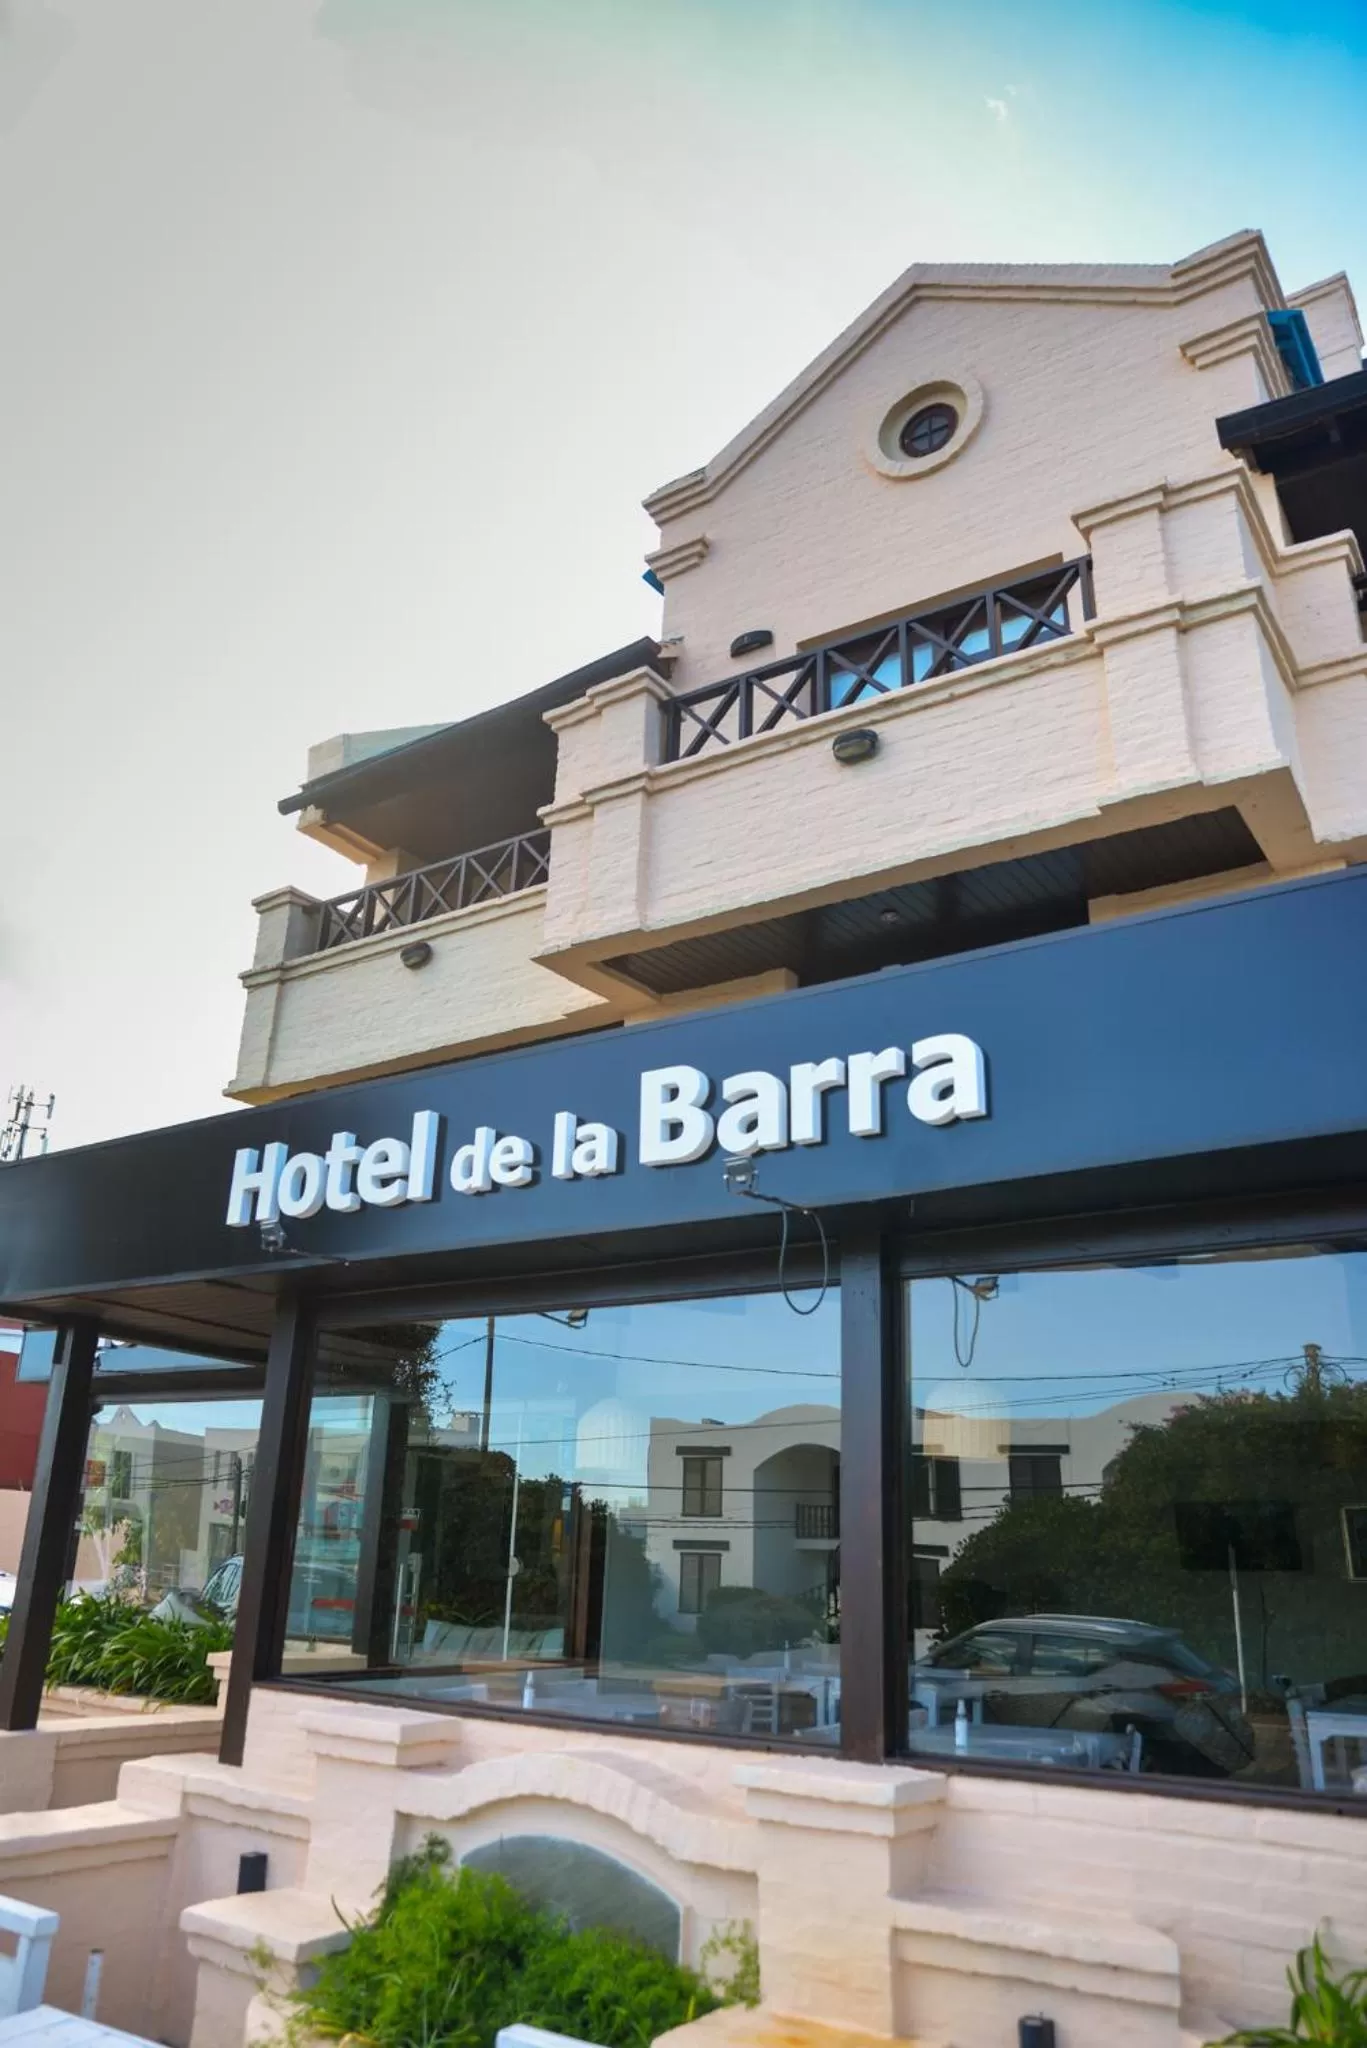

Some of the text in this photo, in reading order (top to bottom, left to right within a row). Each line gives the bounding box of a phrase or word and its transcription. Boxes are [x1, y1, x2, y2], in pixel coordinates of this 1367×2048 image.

[226, 1033, 989, 1227] Hotel de la Barra
